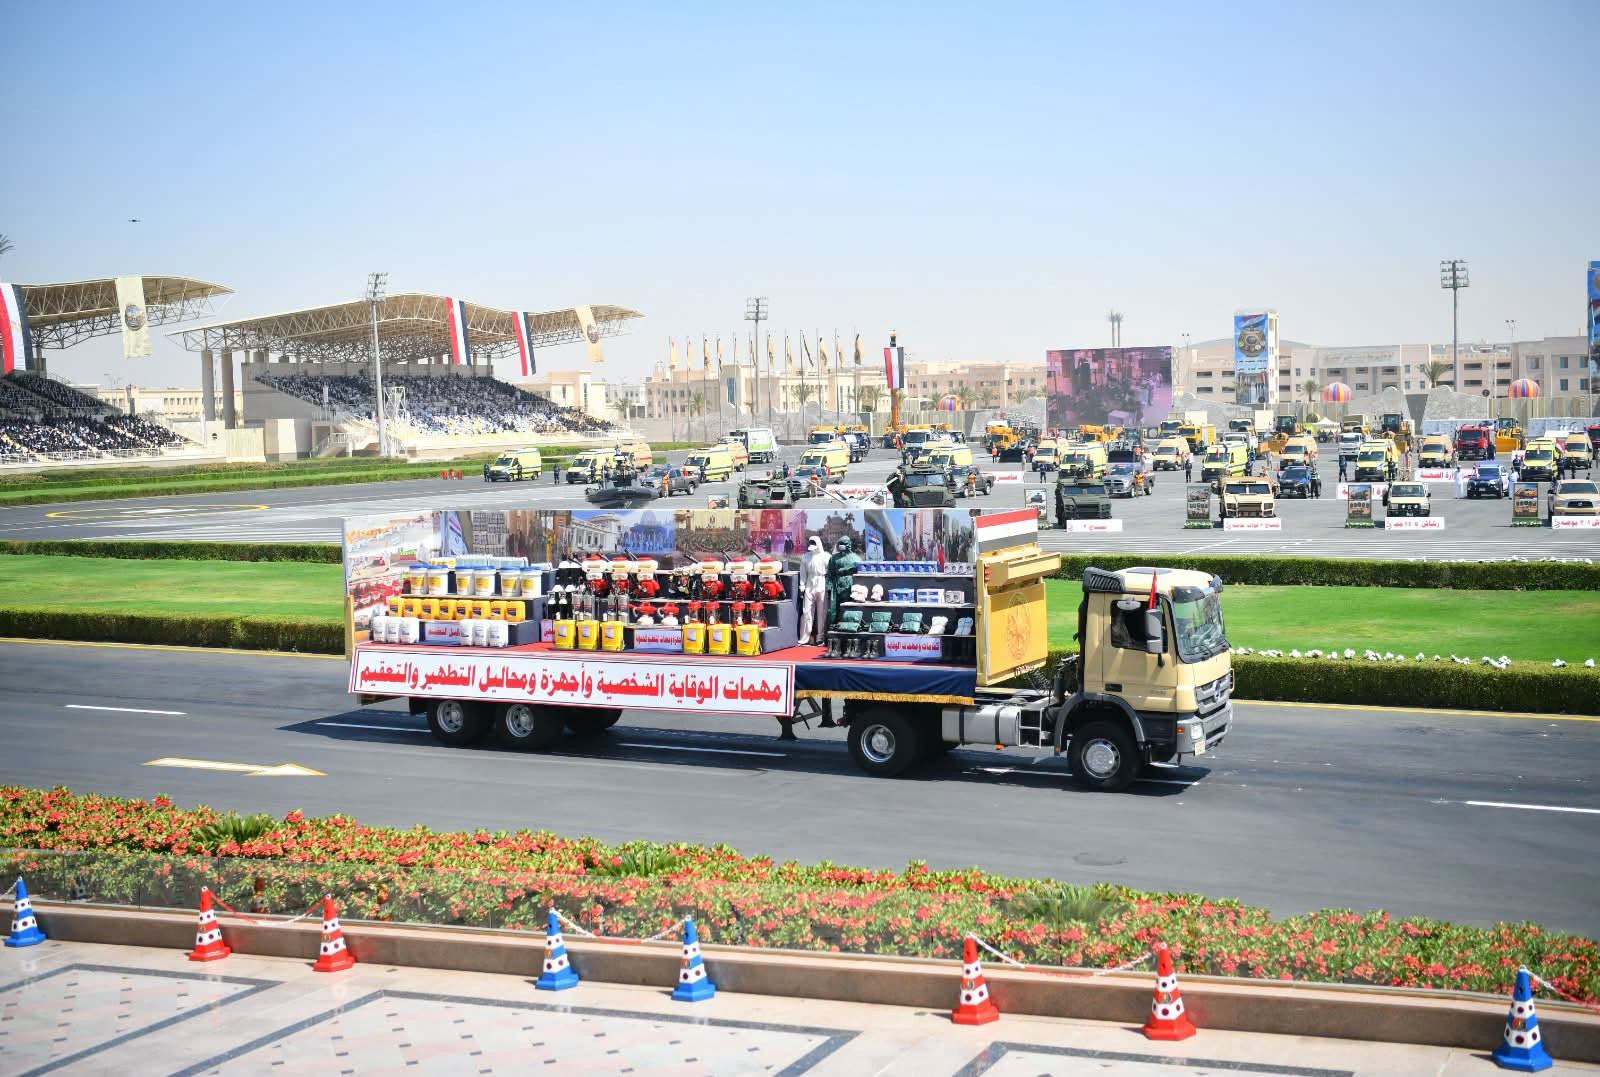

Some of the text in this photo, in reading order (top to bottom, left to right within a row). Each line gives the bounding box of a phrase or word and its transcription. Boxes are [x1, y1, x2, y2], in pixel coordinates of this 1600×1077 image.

[360, 661, 782, 704] مهمات الوقاية الشخصية وأجهزة ومحاليل التطهير والتعقيم
